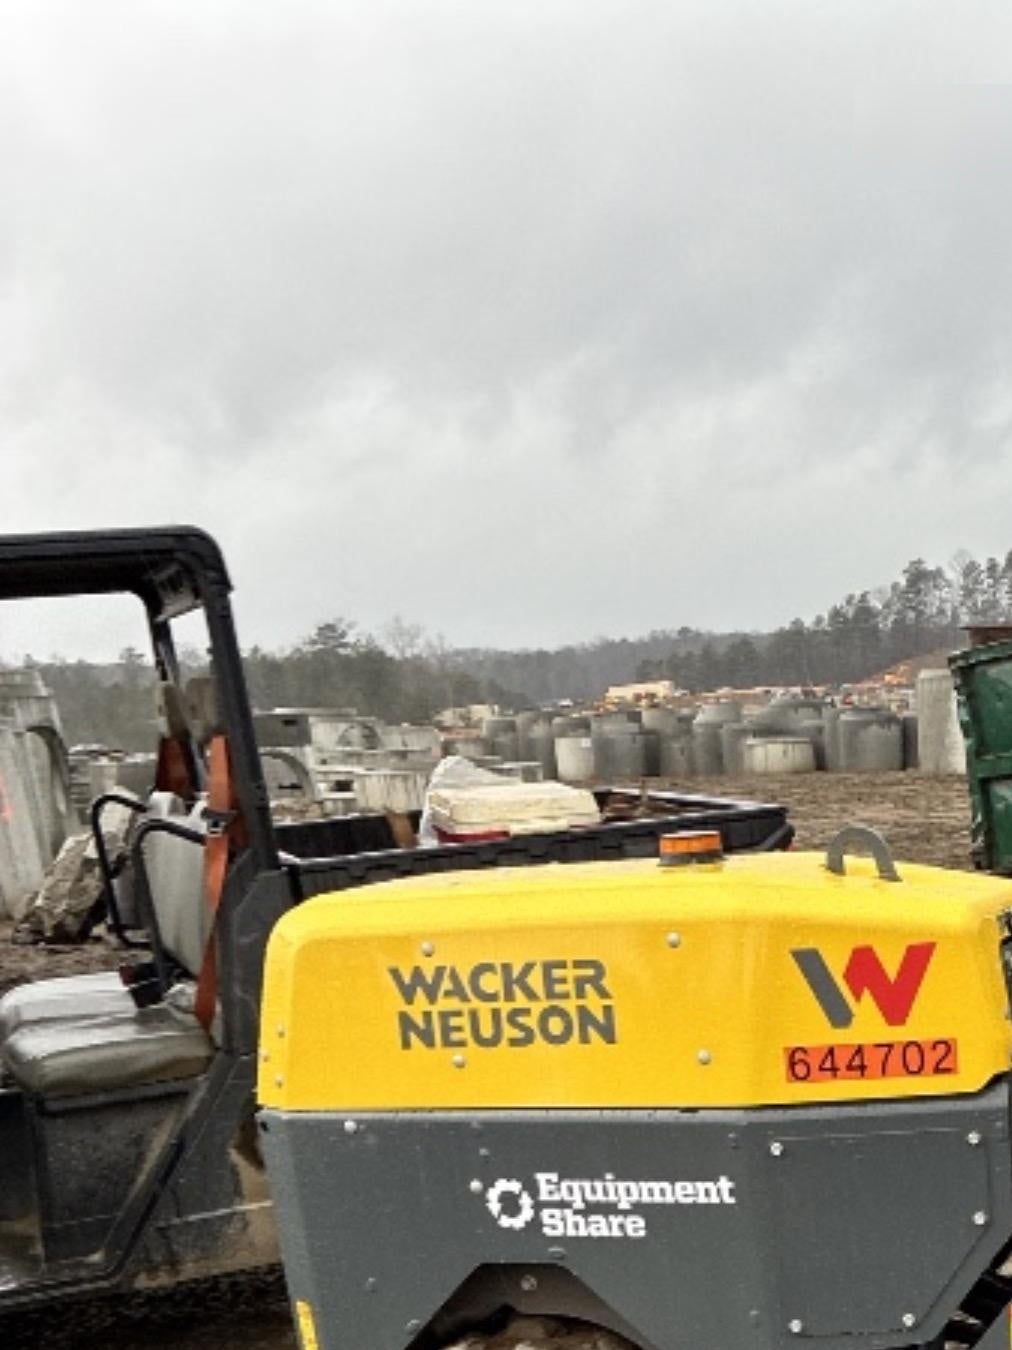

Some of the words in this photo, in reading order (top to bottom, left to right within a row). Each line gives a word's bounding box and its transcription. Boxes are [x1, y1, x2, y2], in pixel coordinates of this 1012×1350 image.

[388, 959, 614, 1005] WACKER
[398, 1004, 616, 1050] NEUSON
[788, 1040, 953, 1081] 644702
[536, 1172, 736, 1207] Equipment
[540, 1208, 646, 1238] Share
